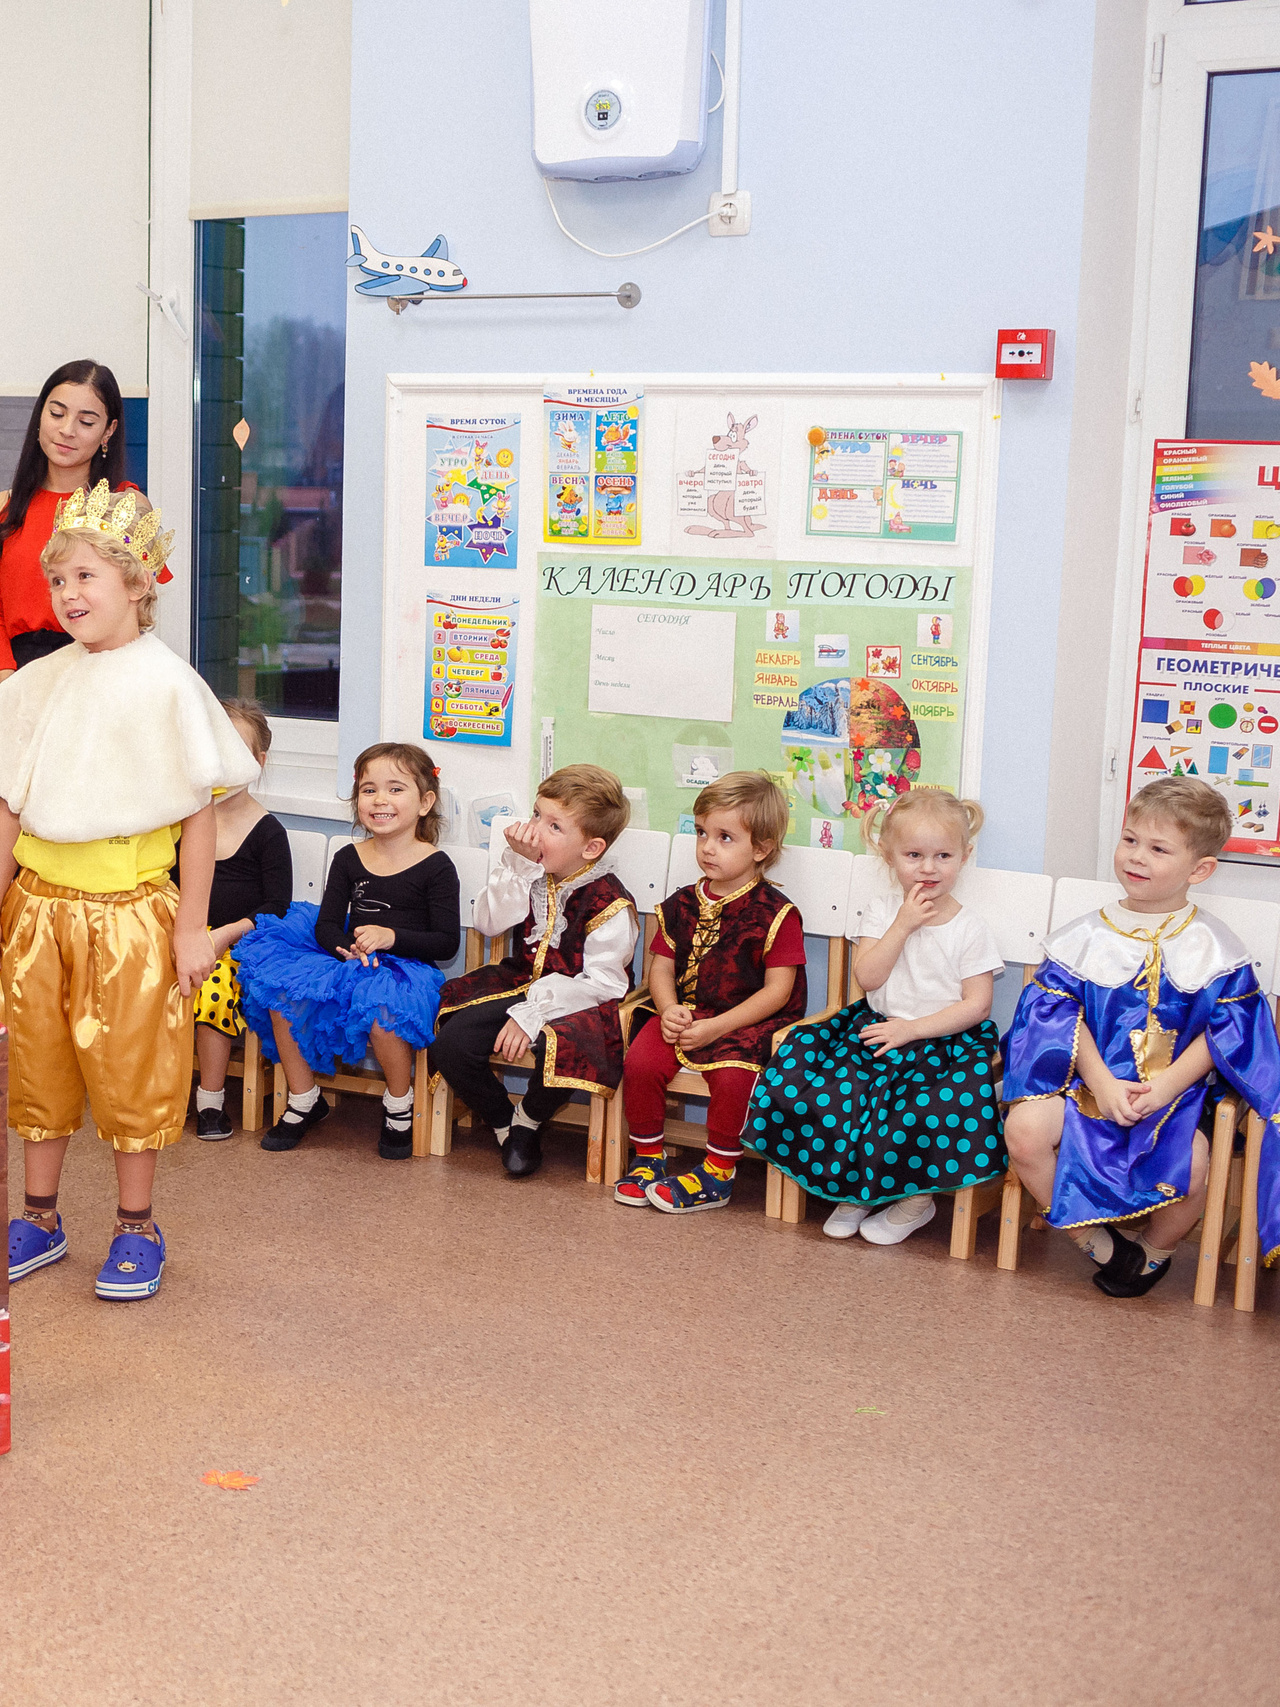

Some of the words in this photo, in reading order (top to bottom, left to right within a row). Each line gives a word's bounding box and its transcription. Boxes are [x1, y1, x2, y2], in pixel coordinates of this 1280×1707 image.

[606, 388, 628, 396] ГОДА
[554, 412, 585, 421] ЗИМА
[602, 412, 630, 422] ЛЕТО
[858, 432, 888, 440] СУТОК
[900, 433, 948, 444] ВЕЧЕР
[828, 441, 871, 454] УТРО
[1163, 448, 1197, 456] КРАСНЫЙ
[440, 457, 468, 467] УТРО
[708, 453, 735, 461] сегодня
[1163, 456, 1207, 464] ОРАНЖЕВЫЙ
[480, 470, 510, 480] ДЕНЬ
[551, 476, 586, 485] ВЕСНА
[597, 478, 634, 487] ОСЕНЬ
[738, 480, 763, 488] завтра
[901, 480, 938, 490] НОЧЬ
[1162, 483, 1194, 491] ГОЛУБОЙ
[817, 488, 858, 502] ДЕНЬ
[1160, 492, 1184, 500] СИНИЙ
[1159, 499, 1208, 509] ФИОЛЕТОВЫЙ
[434, 512, 468, 522] ВЕЧЕР
[474, 530, 505, 540] НОЧЬ
[541, 565, 772, 602] КАЛЕНДАРЬ
[787, 568, 957, 603] ПОГОДЫ
[449, 594, 467, 602] ДНИ
[468, 595, 501, 604] НЕДЕЛИ
[451, 617, 508, 626] ПОНЕДЕЛЬНИК
[637, 613, 692, 625] СЕГОДНЯ
[596, 627, 616, 635] Число
[453, 634, 488, 642] ВТОРНИК
[1201, 642, 1227, 650] ТЕПЛЫЕ
[1229, 643, 1251, 651] ЦВЕТА
[436, 650, 442, 658] 3
[474, 653, 500, 661] СРЕДА
[595, 653, 615, 662] Месяц
[755, 651, 800, 666] ДЕКАБРЬ
[911, 653, 959, 668] СЕНТЯБРЬ
[435, 667, 441, 675] 4
[451, 668, 484, 676] ЧЕТВЕРГ
[611, 680, 631, 688] недели
[754, 672, 798, 687] ЯНВАРЬ
[911, 679, 959, 693] ОКТЯБРЬ
[1183, 681, 1250, 694] ПЛОСКИЕ
[464, 687, 500, 696] ПЯТНИЦА
[434, 701, 440, 709] 6
[450, 703, 484, 711] СУББОТА
[753, 694, 799, 708] ФЕВРАЛЬ
[912, 704, 955, 717] НОЯБРЬ
[448, 721, 501, 731] ВОСКРЕСЕНЬЕ
